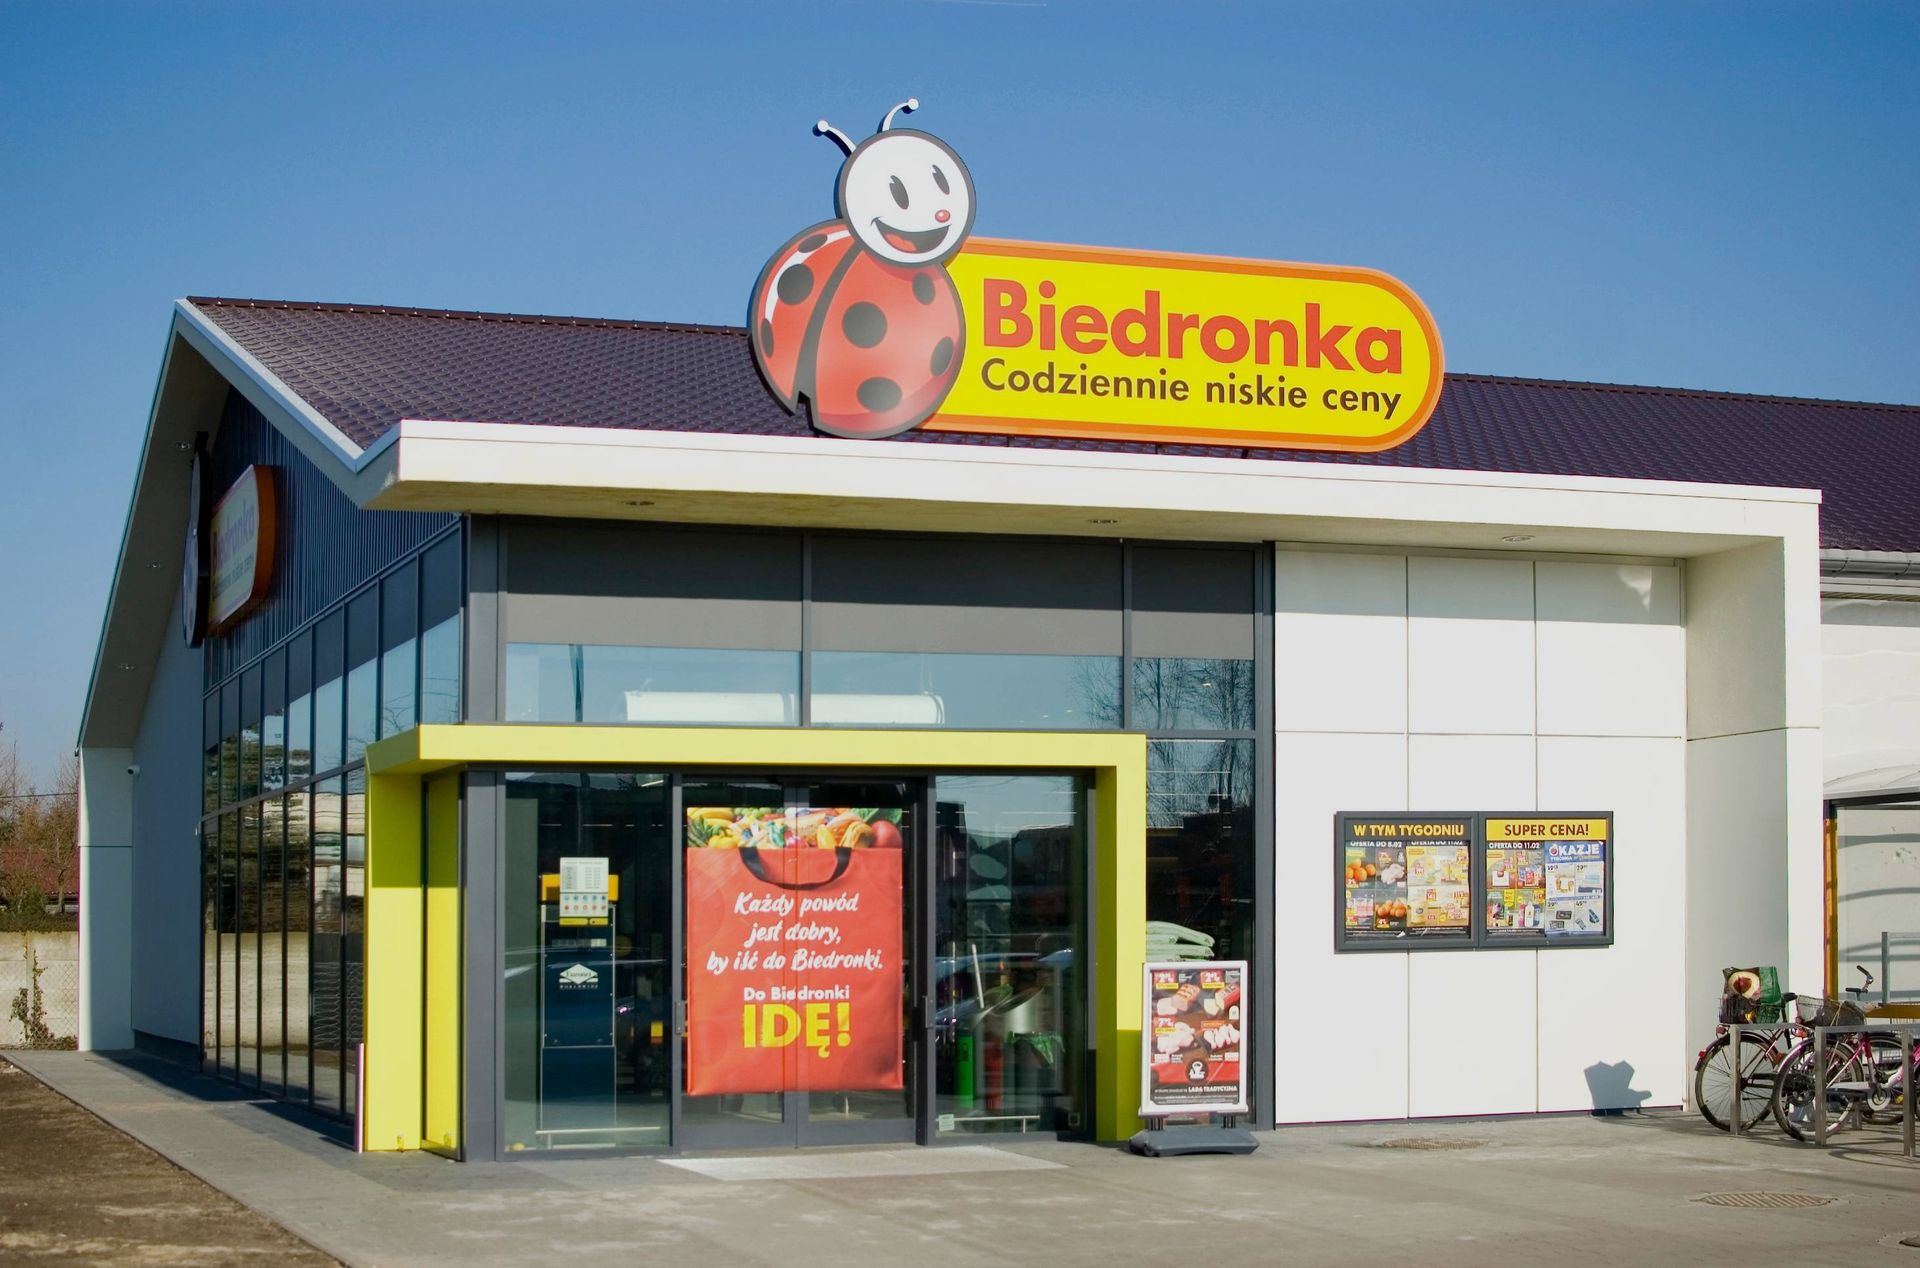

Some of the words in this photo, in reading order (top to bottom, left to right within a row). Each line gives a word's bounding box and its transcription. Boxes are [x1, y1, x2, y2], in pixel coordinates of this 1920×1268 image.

[983, 277, 1402, 374] Biedronka
[981, 357, 1189, 401] Codziennie
[1206, 372, 1307, 408] niskie
[1322, 388, 1401, 420] ceny
[1353, 824, 1366, 836] W
[1369, 824, 1396, 836] TYM
[1399, 824, 1464, 836] TYGODNIU
[1504, 824, 1546, 836] SUPER
[1549, 824, 1589, 836] CENA!
[1548, 843, 1600, 857] OKAZJE
[734, 891, 794, 917] Każdy
[799, 892, 860, 917] powód
[743, 920, 783, 948] jest
[785, 921, 842, 945] dobry,
[706, 950, 729, 975] by
[733, 950, 760, 971] iść
[762, 951, 786, 970] do
[790, 948, 883, 972] Biedronki.
[743, 987, 766, 1001] Do
[771, 984, 850, 1001] Biedronki
[743, 1002, 851, 1059] IDĘ!
